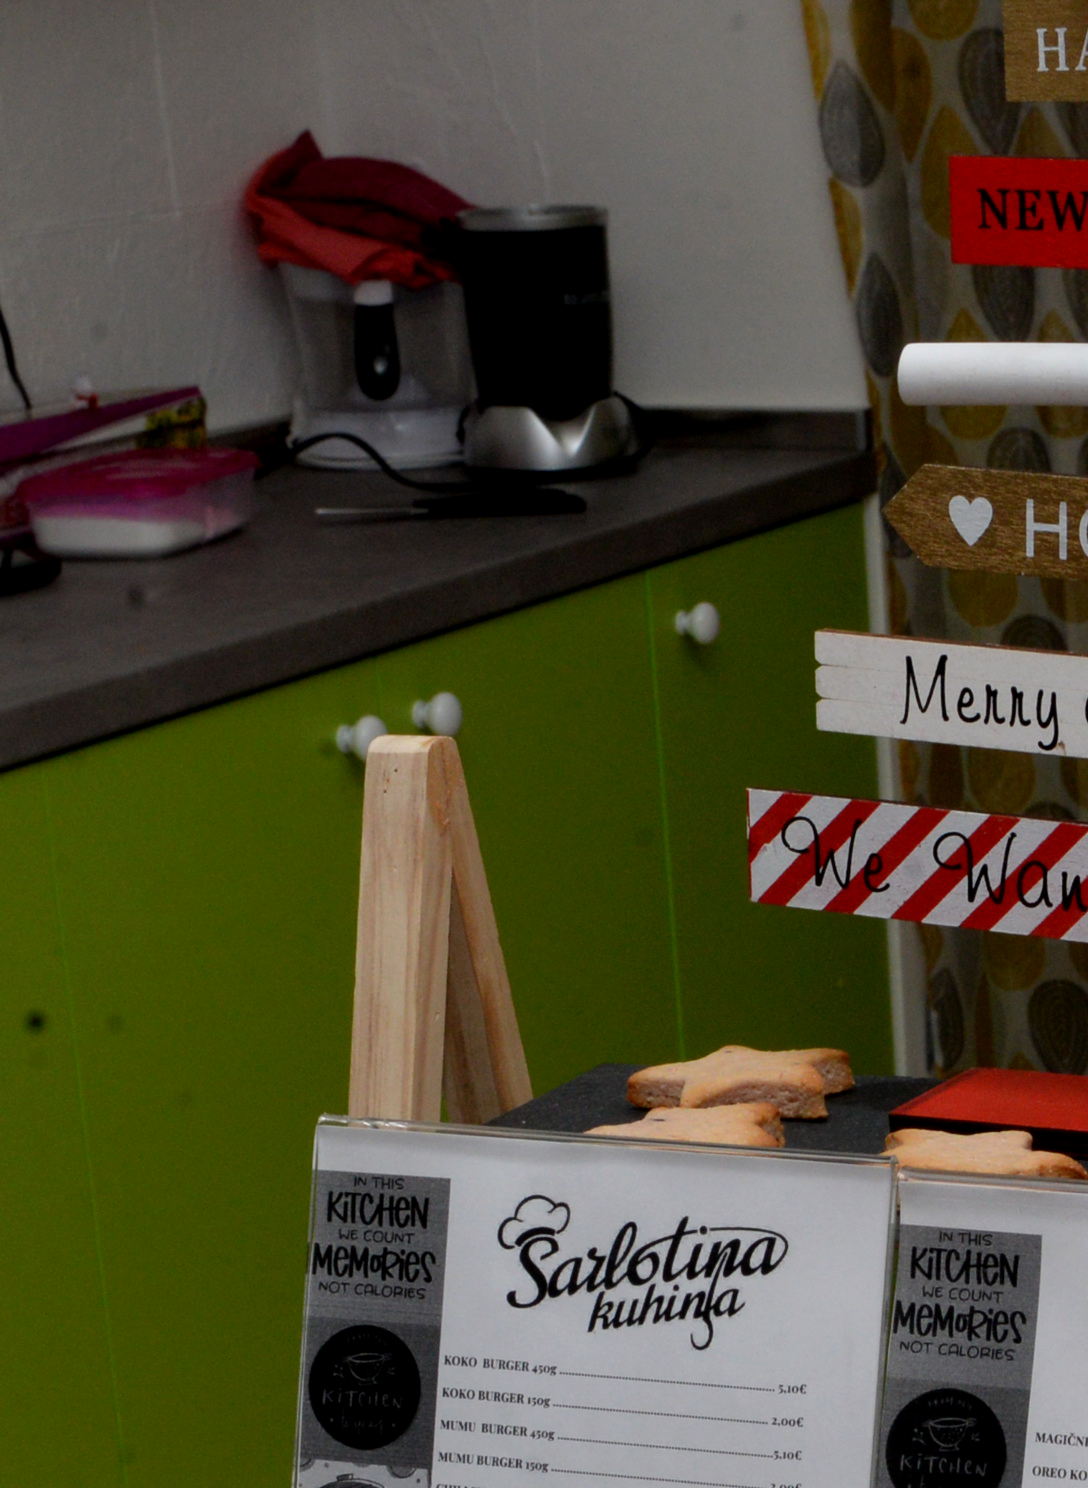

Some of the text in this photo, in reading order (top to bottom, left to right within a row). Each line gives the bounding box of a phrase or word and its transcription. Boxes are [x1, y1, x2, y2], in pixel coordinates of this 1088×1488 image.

[900, 654, 1062, 752] Merry
[781, 816, 891, 892] We
[353, 1176, 405, 1190] IN THIS
[339, 1229, 414, 1244] WE COUNT
[939, 1231, 992, 1246] IN THIS
[318, 1282, 426, 1299] NOT CALORIES
[922, 1287, 1003, 1303] WE COUNT
[587, 1284, 745, 1350] kuhinja
[899, 1341, 1015, 1361] NOT CALORIES
[443, 1354, 478, 1368] KOKO
[482, 1357, 530, 1373] BURGER
[531, 1364, 558, 1377] 450g
[1031, 1465, 1068, 1479] OREO
